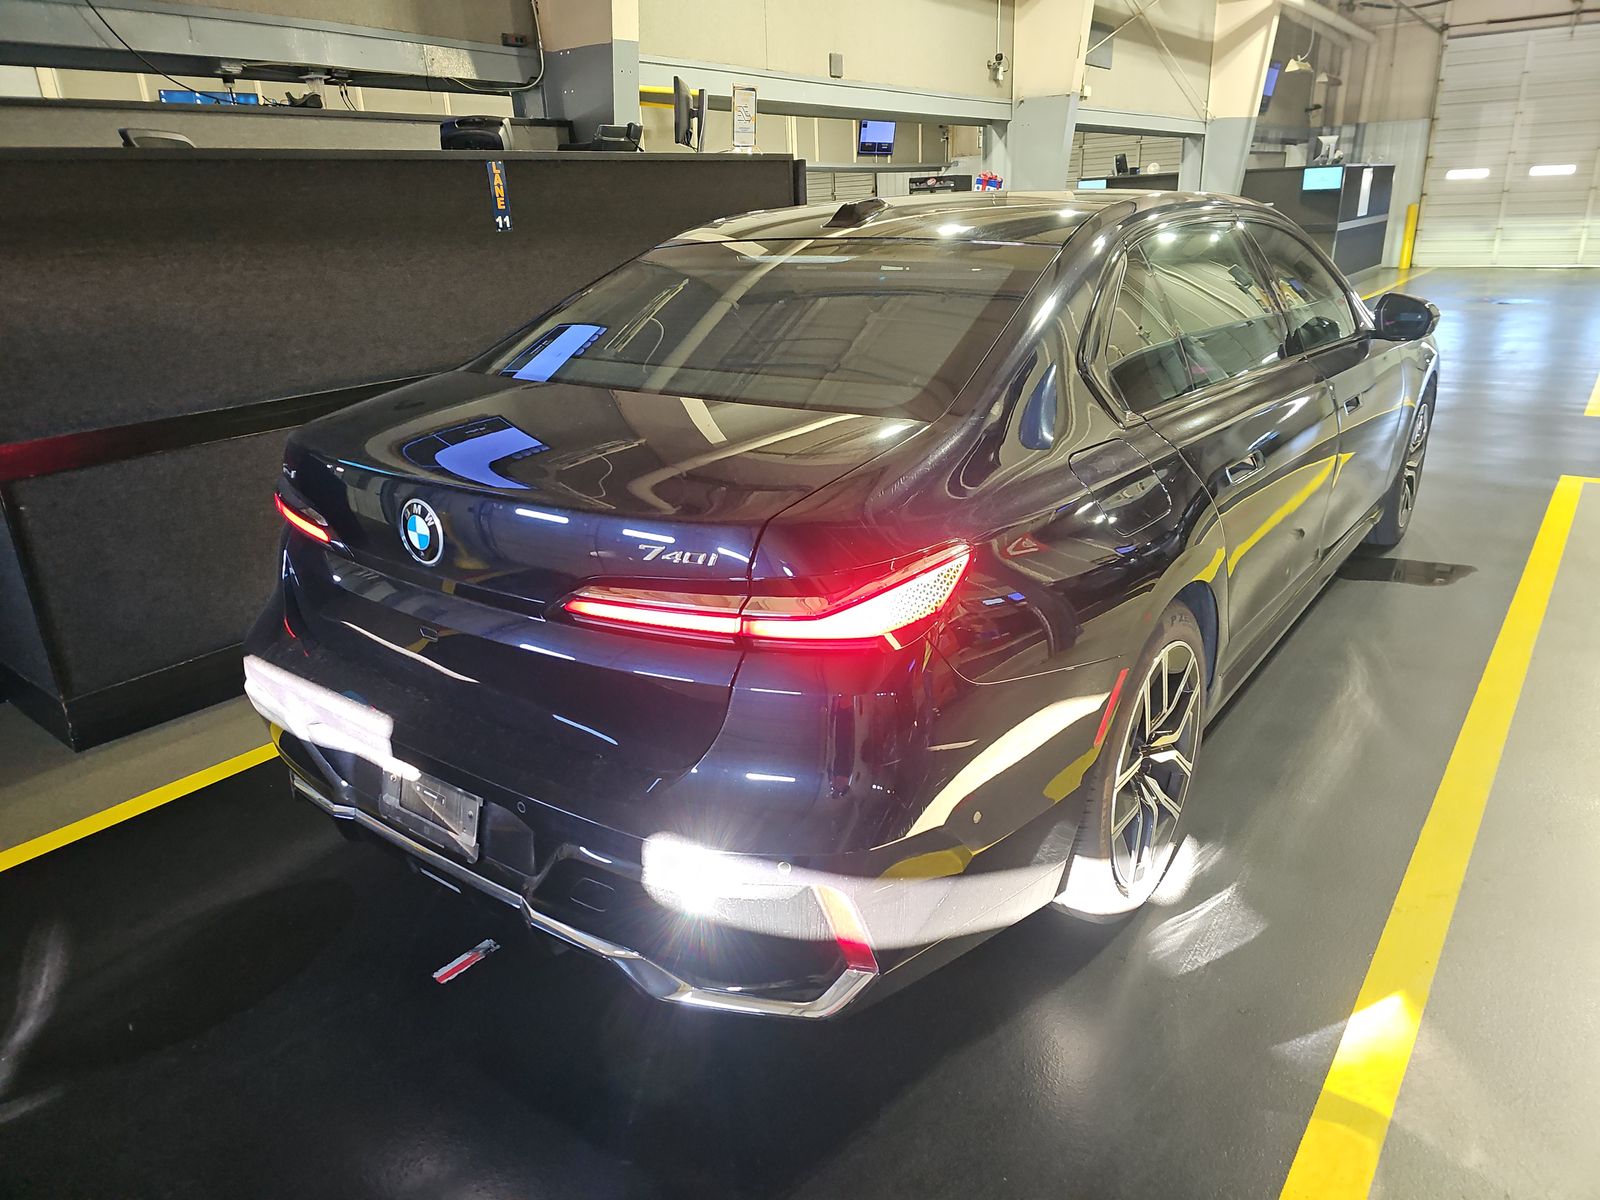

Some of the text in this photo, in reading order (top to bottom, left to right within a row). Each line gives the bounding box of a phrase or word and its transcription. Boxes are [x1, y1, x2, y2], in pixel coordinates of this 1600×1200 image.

[491, 161, 506, 210] LANE
[495, 215, 511, 229] 11
[403, 502, 435, 527] BMW
